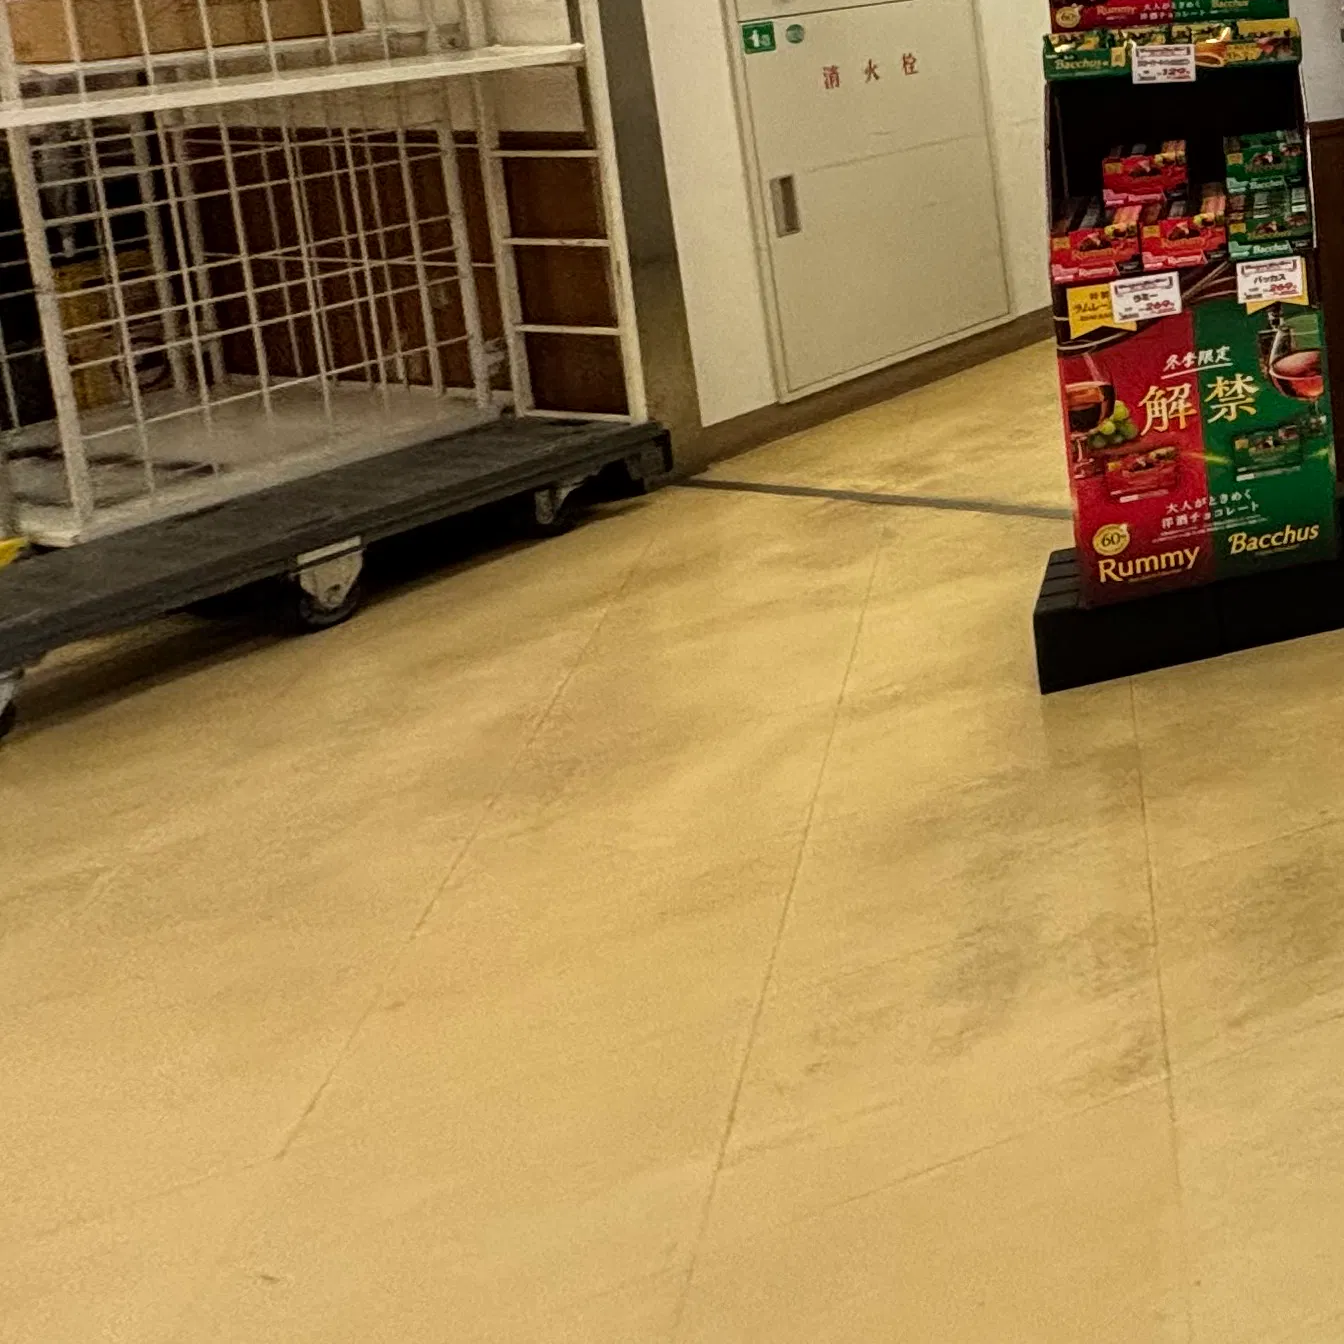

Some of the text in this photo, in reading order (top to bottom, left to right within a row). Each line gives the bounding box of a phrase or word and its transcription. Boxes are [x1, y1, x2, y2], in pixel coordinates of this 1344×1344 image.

[822, 52, 920, 91] 消火栓
[1253, 273, 1287, 284] バッカス
[1163, 345, 1232, 372] 冬季限定
[1138, 372, 1261, 437] 解禁
[1161, 500, 1260, 530] 洋酒チョコレート
[1165, 488, 1252, 515] 大人がときめく
[1227, 524, 1320, 555] Bacchus
[1097, 546, 1200, 583] Rummy
